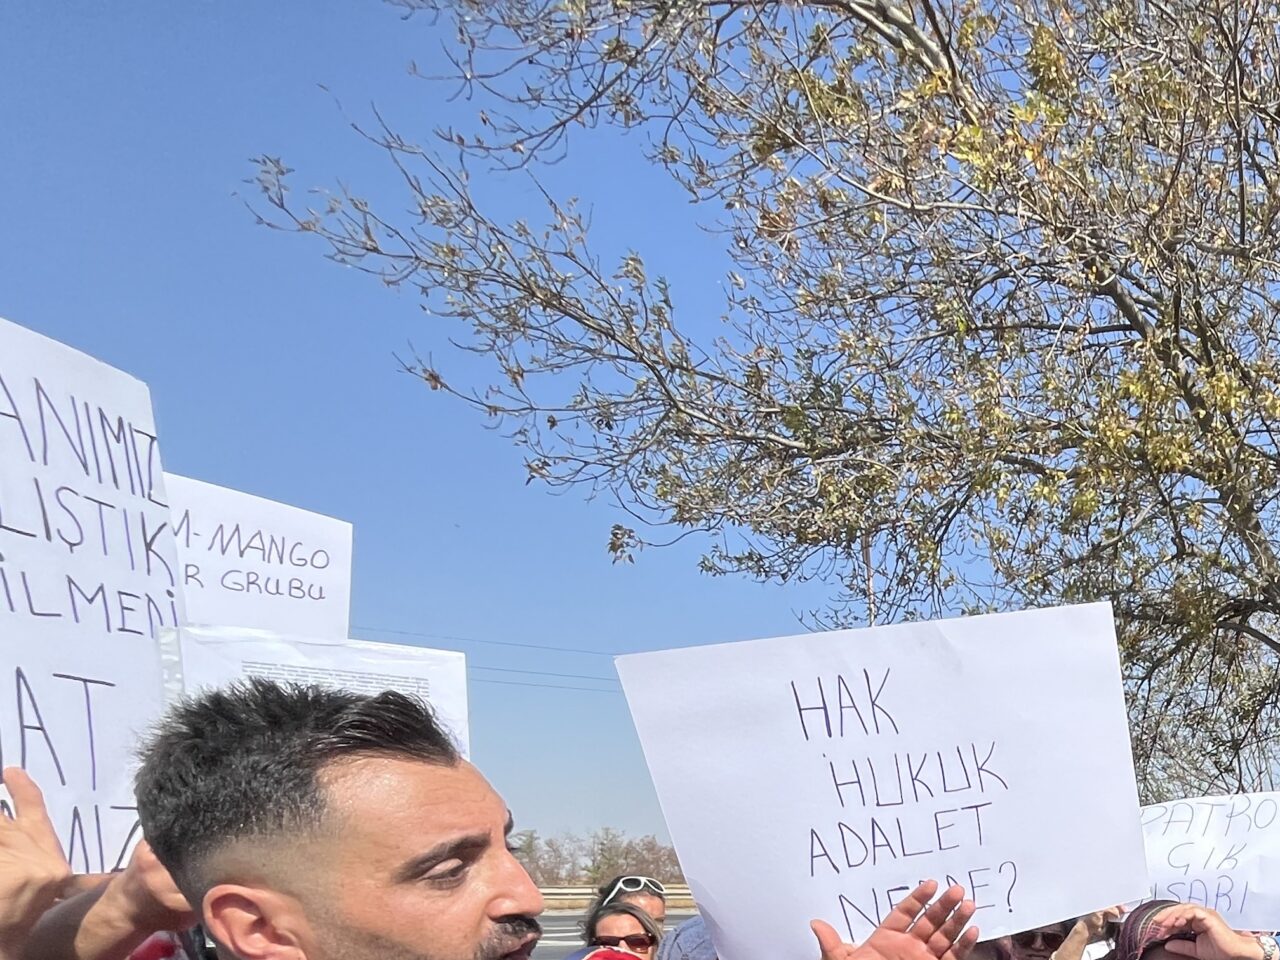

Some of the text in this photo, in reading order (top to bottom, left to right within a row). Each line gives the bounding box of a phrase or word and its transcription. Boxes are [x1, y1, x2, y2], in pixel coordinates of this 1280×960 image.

[221, 569, 326, 601] GRUBU
[791, 668, 899, 740] HAK
[810, 801, 993, 877] ADALET
